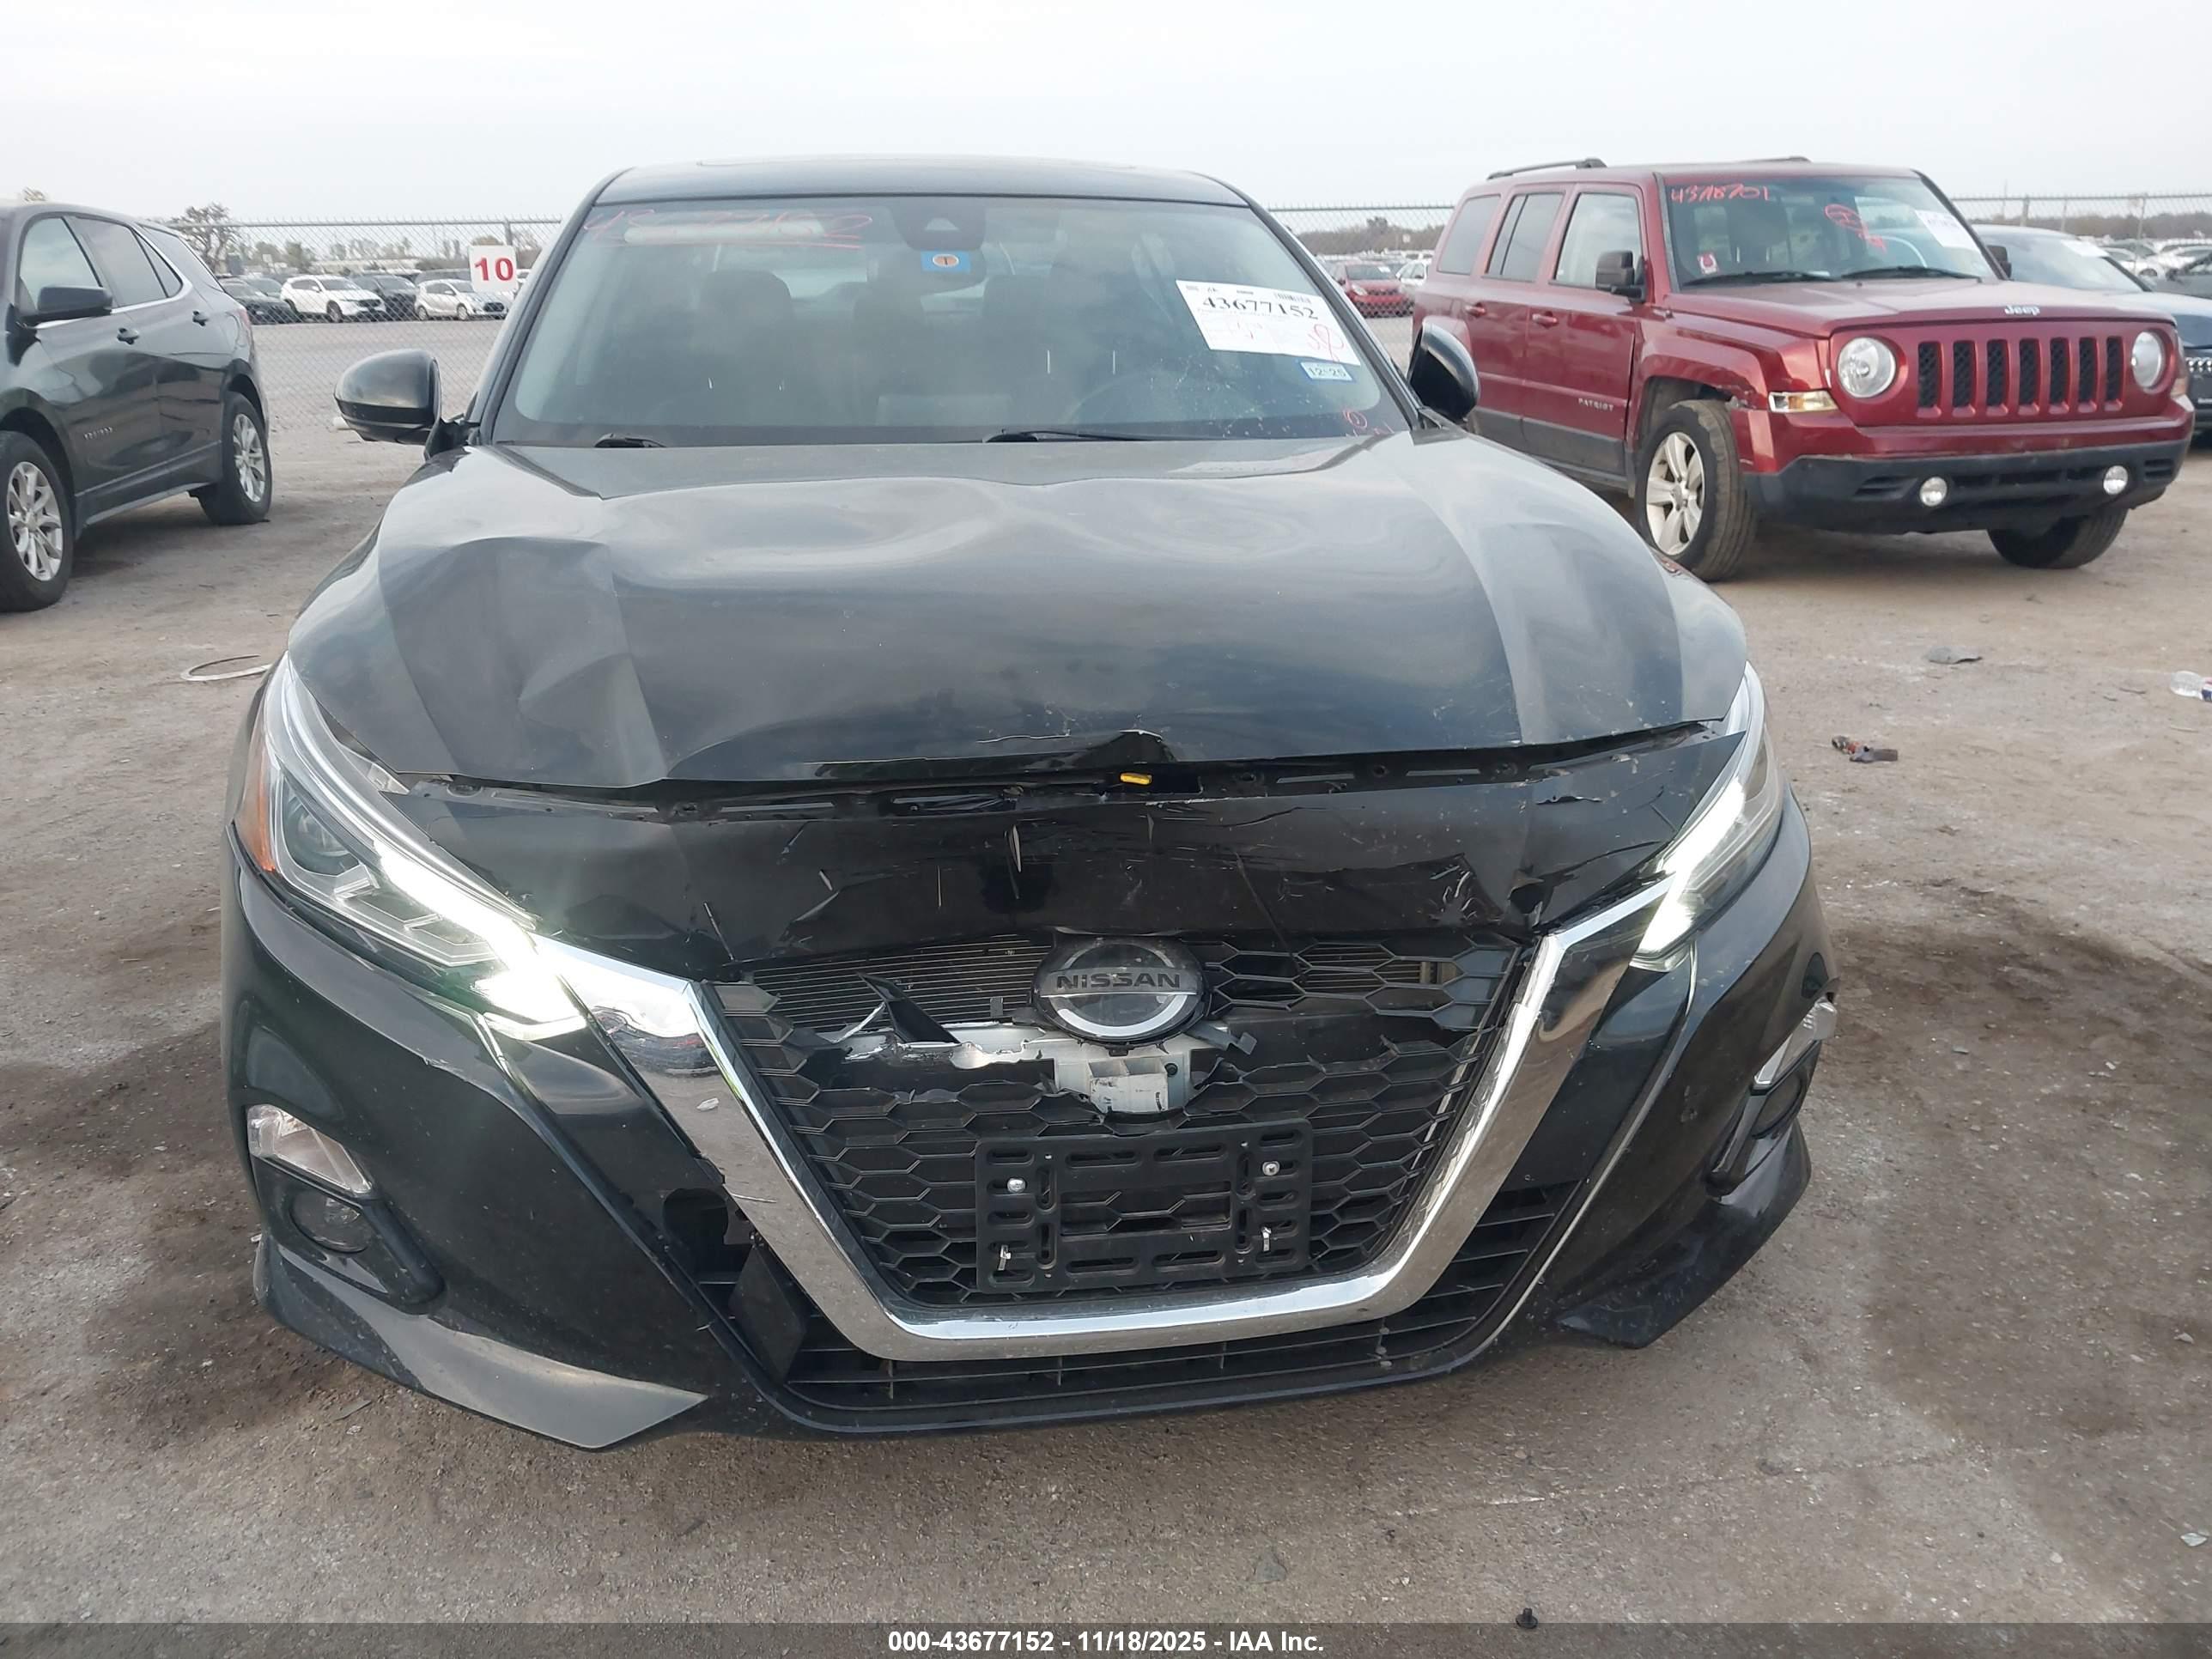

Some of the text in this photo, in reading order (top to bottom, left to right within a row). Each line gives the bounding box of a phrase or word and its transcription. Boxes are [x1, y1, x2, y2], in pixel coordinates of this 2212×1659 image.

[474, 257, 514, 282] 10
[1203, 296, 1319, 319] 43677152
[2004, 304, 2041, 316] Jeep
[1578, 398, 1614, 412] PATRIOT
[1056, 972, 1181, 989] NISSAN
